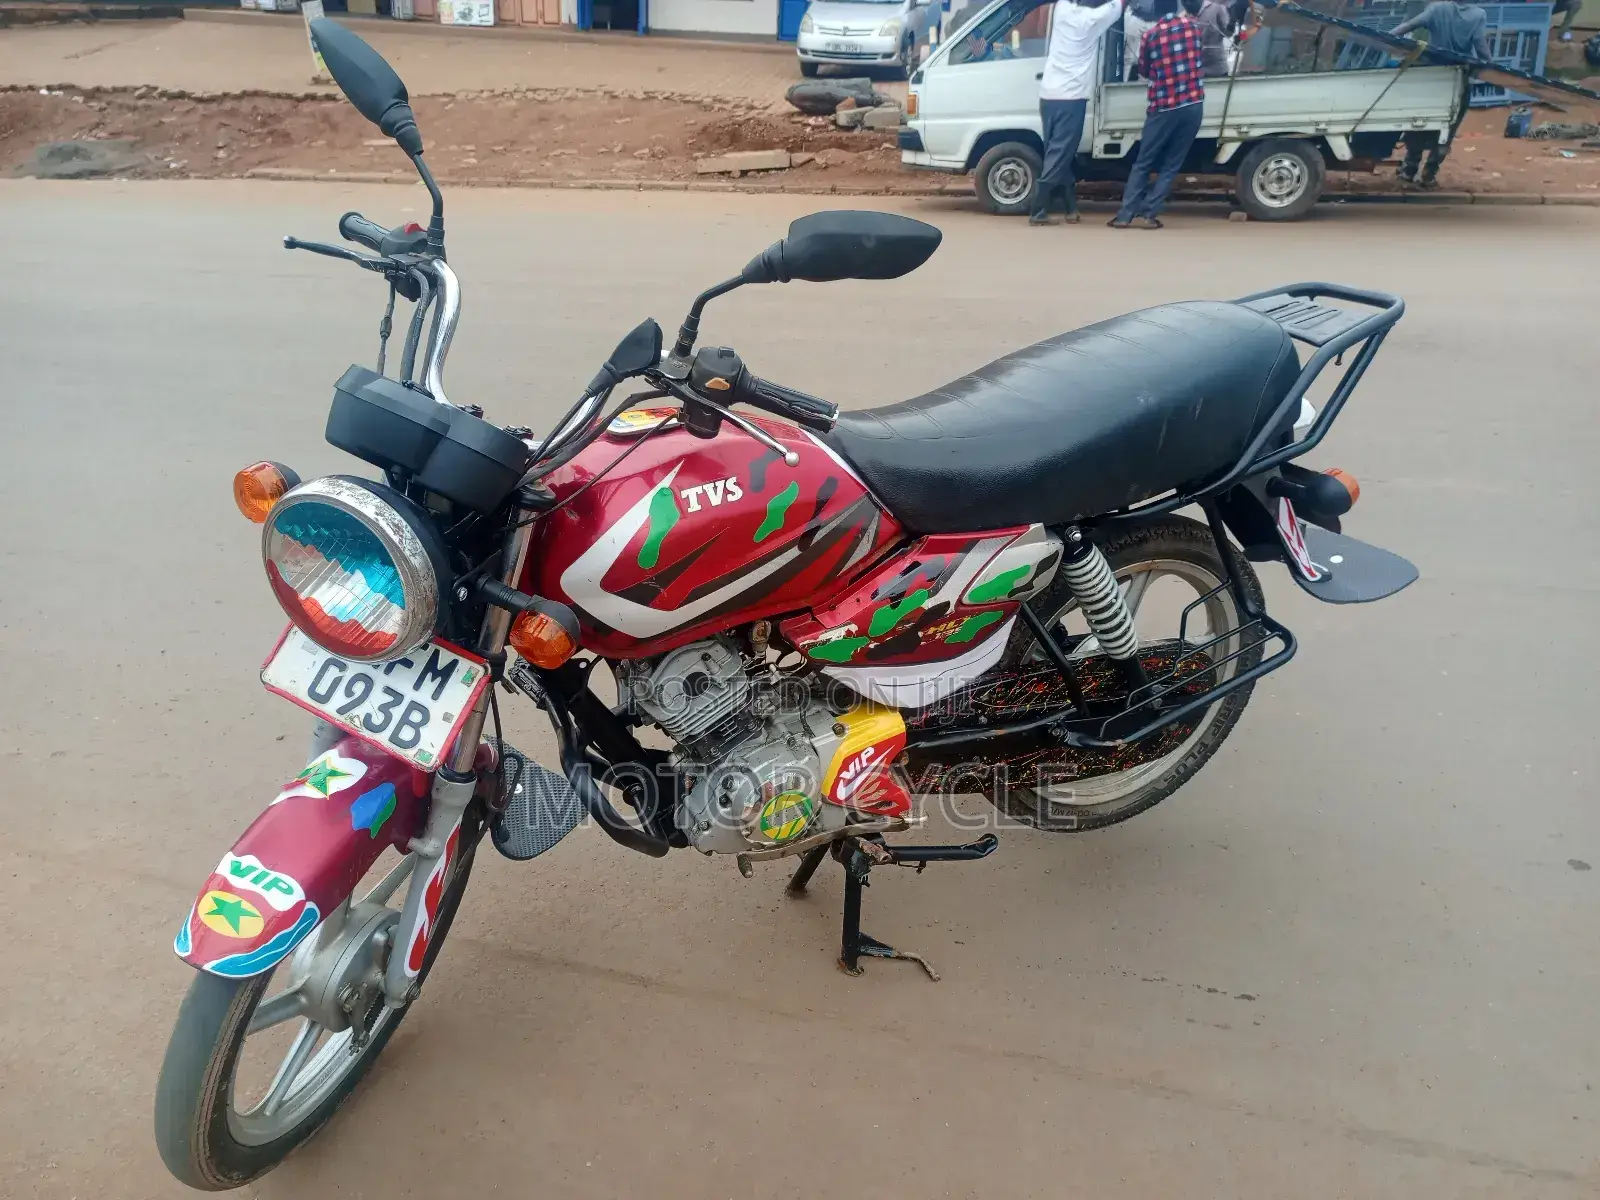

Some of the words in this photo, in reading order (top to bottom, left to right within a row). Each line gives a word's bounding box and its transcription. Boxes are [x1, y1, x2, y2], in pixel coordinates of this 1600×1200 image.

[681, 476, 743, 513] TVS
[307, 656, 431, 749] 093B
[839, 746, 875, 779] VIP
[230, 859, 294, 896] VIP
